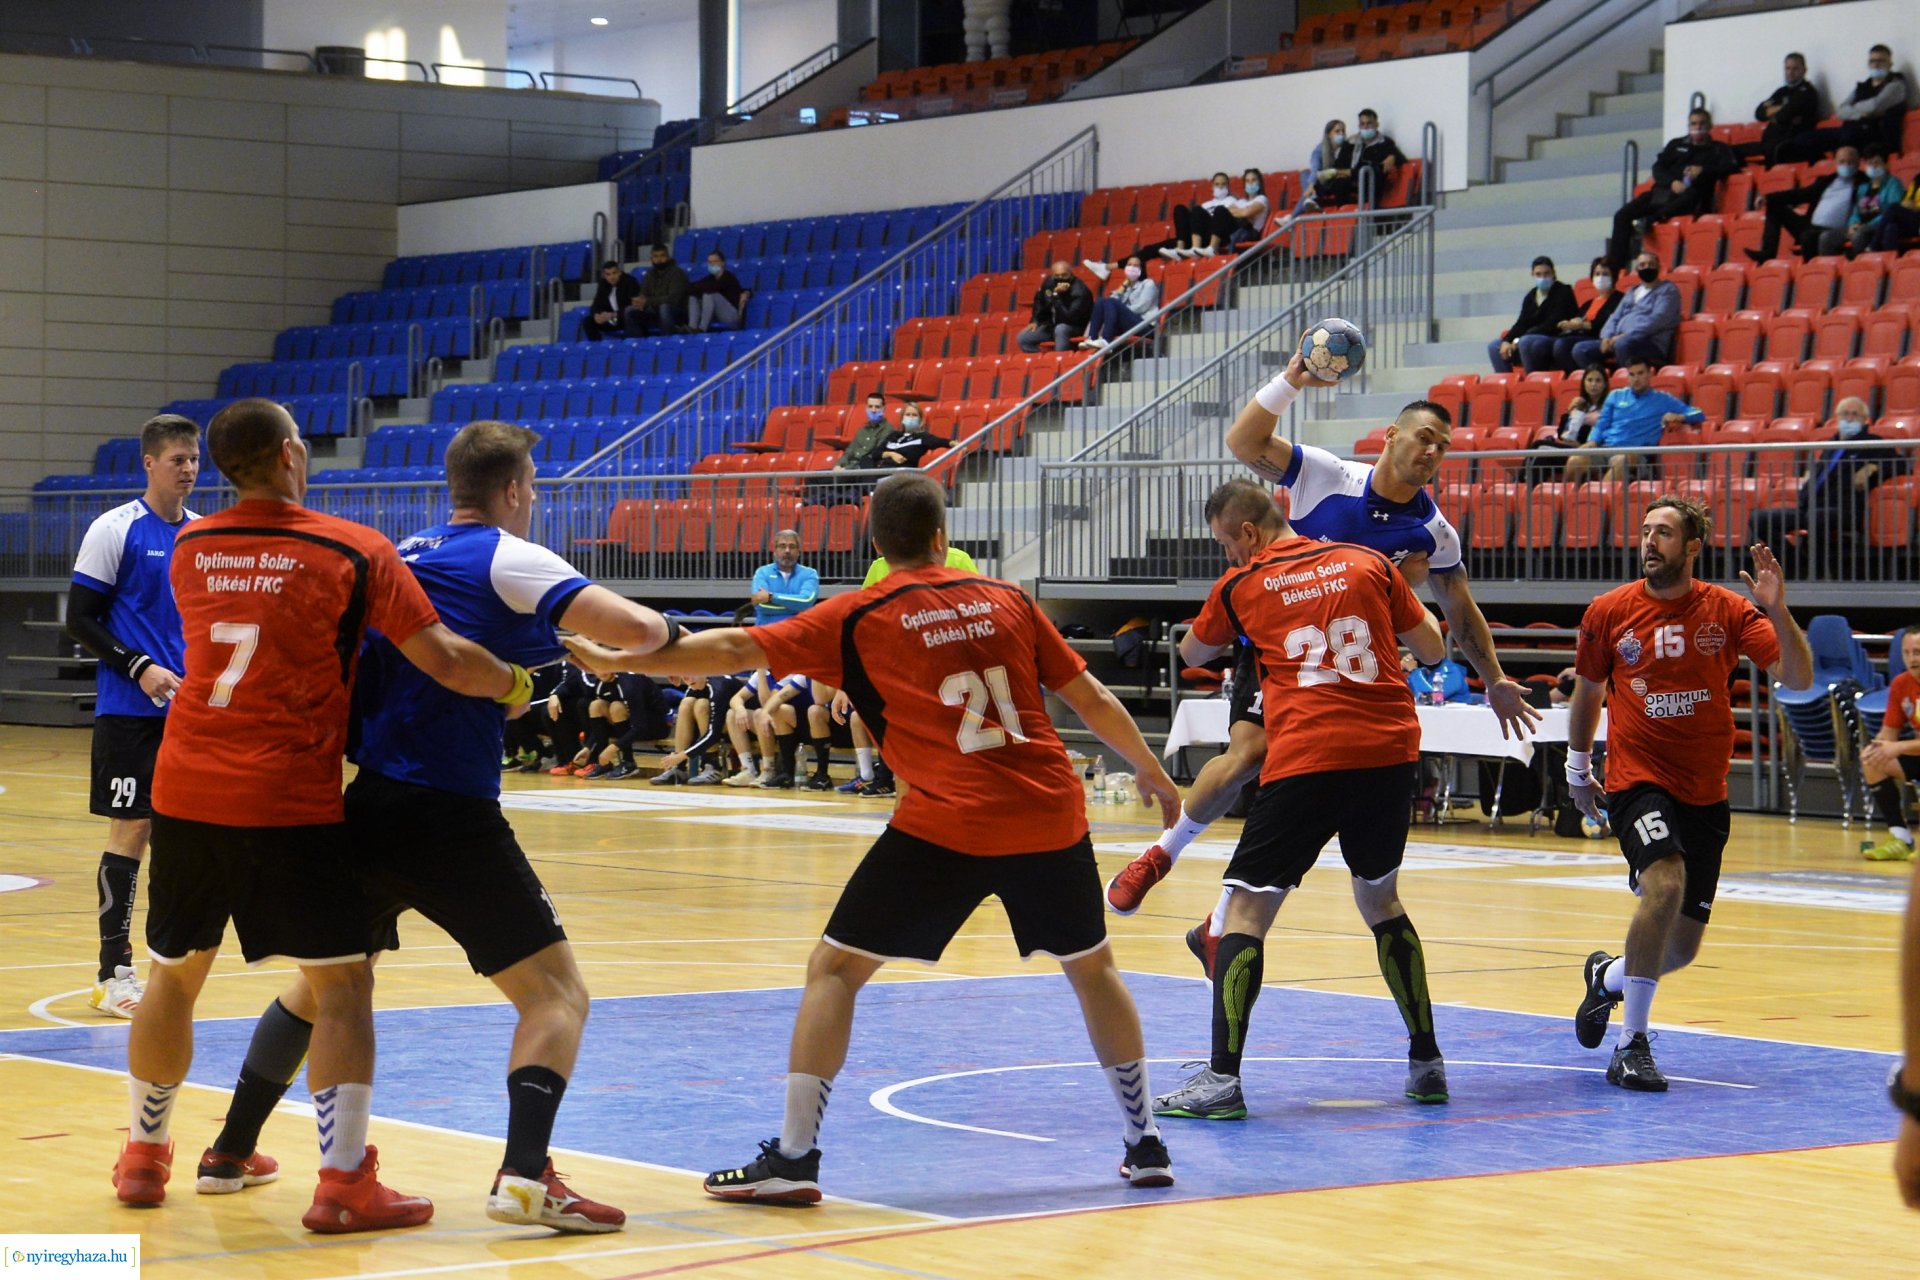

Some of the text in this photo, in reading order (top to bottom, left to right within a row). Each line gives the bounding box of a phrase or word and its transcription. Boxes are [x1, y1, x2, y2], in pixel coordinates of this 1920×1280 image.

[146, 549, 165, 557] JAKO
[195, 552, 255, 573] Optimum
[259, 552, 297, 571] Solar
[206, 575, 284, 594] Békési FKC
[1263, 570, 1316, 592] Optimum
[1316, 561, 1348, 579] Solar
[1281, 577, 1348, 606] Békési FKC
[901, 608, 958, 631] Optimum
[958, 600, 992, 618] Solar
[922, 620, 996, 648] Békési FKC
[1653, 624, 1686, 660] 15
[208, 621, 260, 708] 7
[1283, 615, 1379, 687] 28
[938, 665, 1030, 754] 21
[1645, 689, 1711, 705] OPTIMUM
[1645, 703, 1694, 718] SOLAR
[110, 777, 137, 808] 29
[1633, 810, 1670, 847] 15
